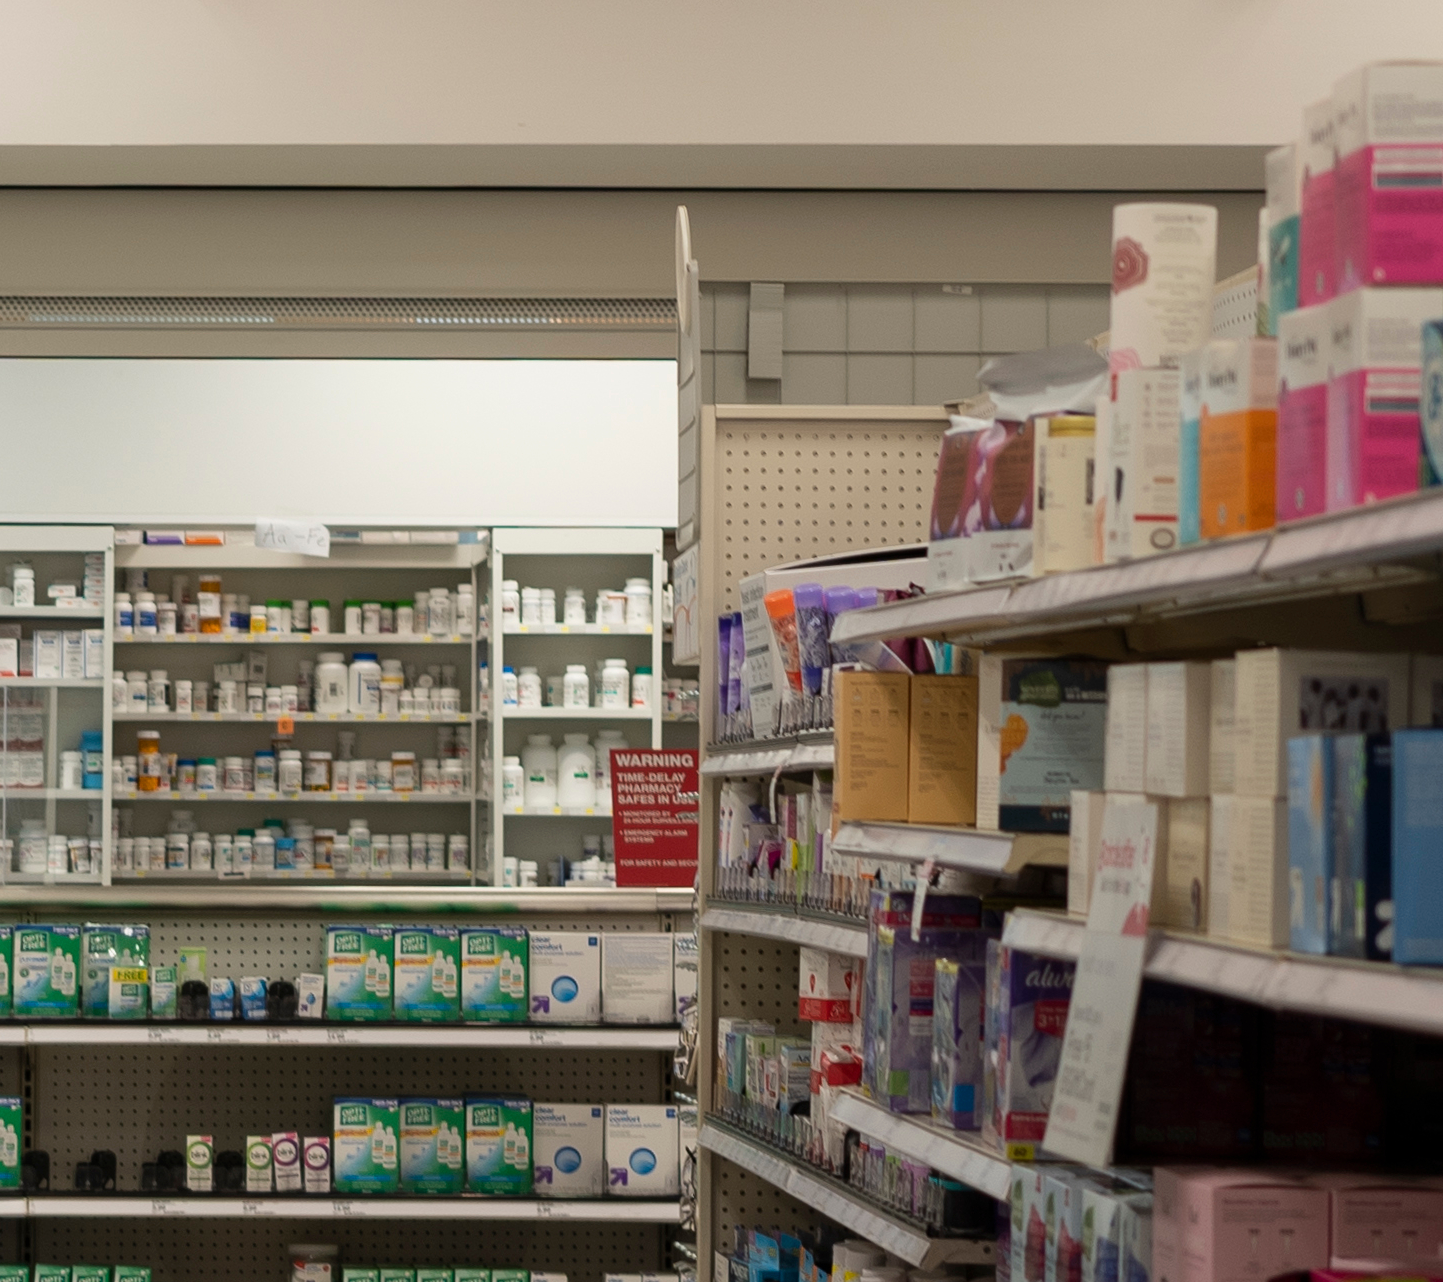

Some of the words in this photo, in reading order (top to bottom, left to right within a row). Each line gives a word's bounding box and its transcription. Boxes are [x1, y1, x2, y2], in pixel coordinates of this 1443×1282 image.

[615, 753, 694, 767] WARNING
[617, 772, 686, 783] TIME-DELAY
[617, 783, 682, 794] PHARMACY
[617, 794, 656, 805] SAFES
[658, 794, 669, 805] IN
[672, 794, 696, 805] USE
[620, 859, 634, 867] FOR
[636, 859, 661, 867] SAFETY
[663, 859, 677, 867] AND
[679, 859, 698, 867] SECU
[531, 943, 563, 951] comfort
[116, 970, 145, 981] FREE
[535, 1114, 566, 1123] comfort
[609, 1115, 640, 1123] comfort
[191, 1150, 207, 1160] blink
[251, 1150, 267, 1160] blink
[277, 1147, 294, 1158] blink
[308, 1151, 324, 1161] blink
